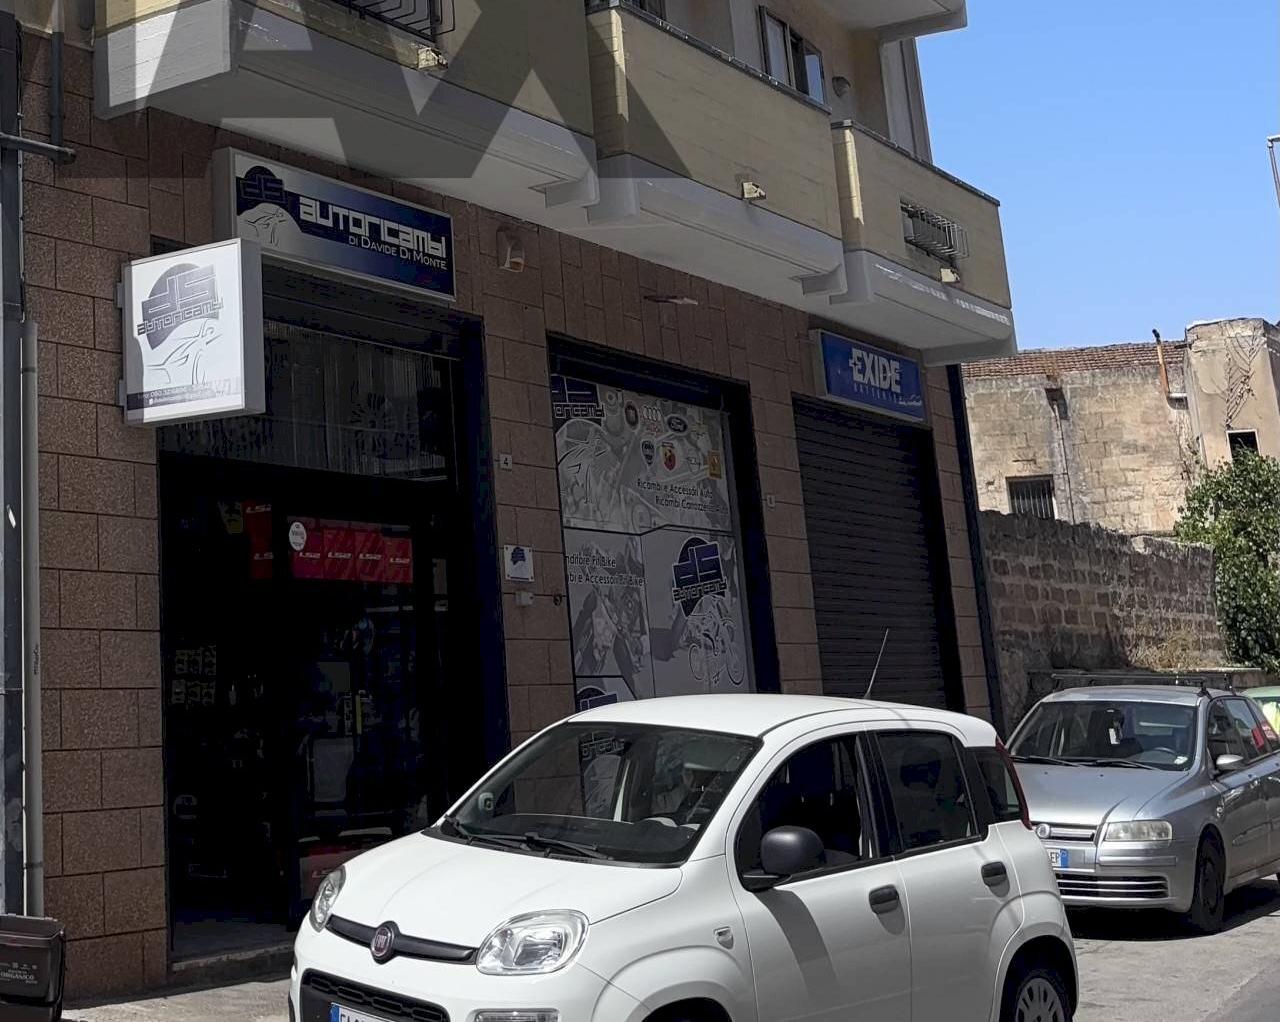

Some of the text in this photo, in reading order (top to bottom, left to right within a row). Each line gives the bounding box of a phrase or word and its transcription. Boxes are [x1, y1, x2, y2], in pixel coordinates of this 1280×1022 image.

[360, 236, 398, 257] DAVIDE
[412, 251, 448, 270] MONTE
[848, 347, 902, 394] EXIDE
[637, 478, 663, 491] Ricambi
[670, 483, 699, 496] Accessori
[655, 495, 681, 508] Ricambi
